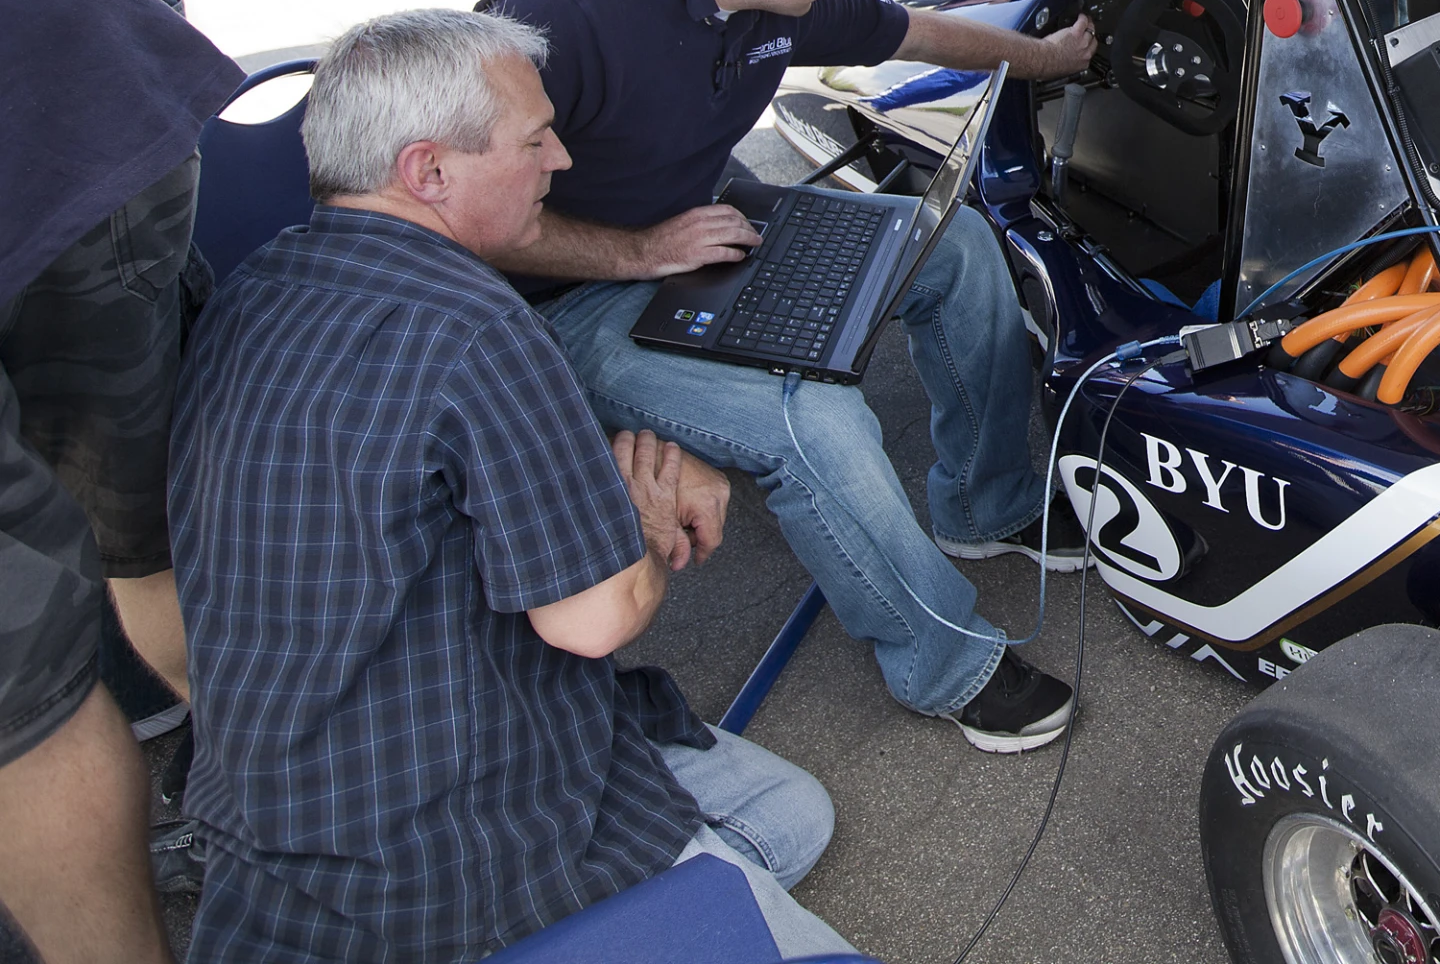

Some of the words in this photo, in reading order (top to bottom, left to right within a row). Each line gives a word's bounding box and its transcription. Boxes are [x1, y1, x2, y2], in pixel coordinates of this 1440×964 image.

[1074, 466, 1163, 574] 2
[1140, 432, 1291, 531] BYU
[1225, 743, 1384, 843] Hoosier
